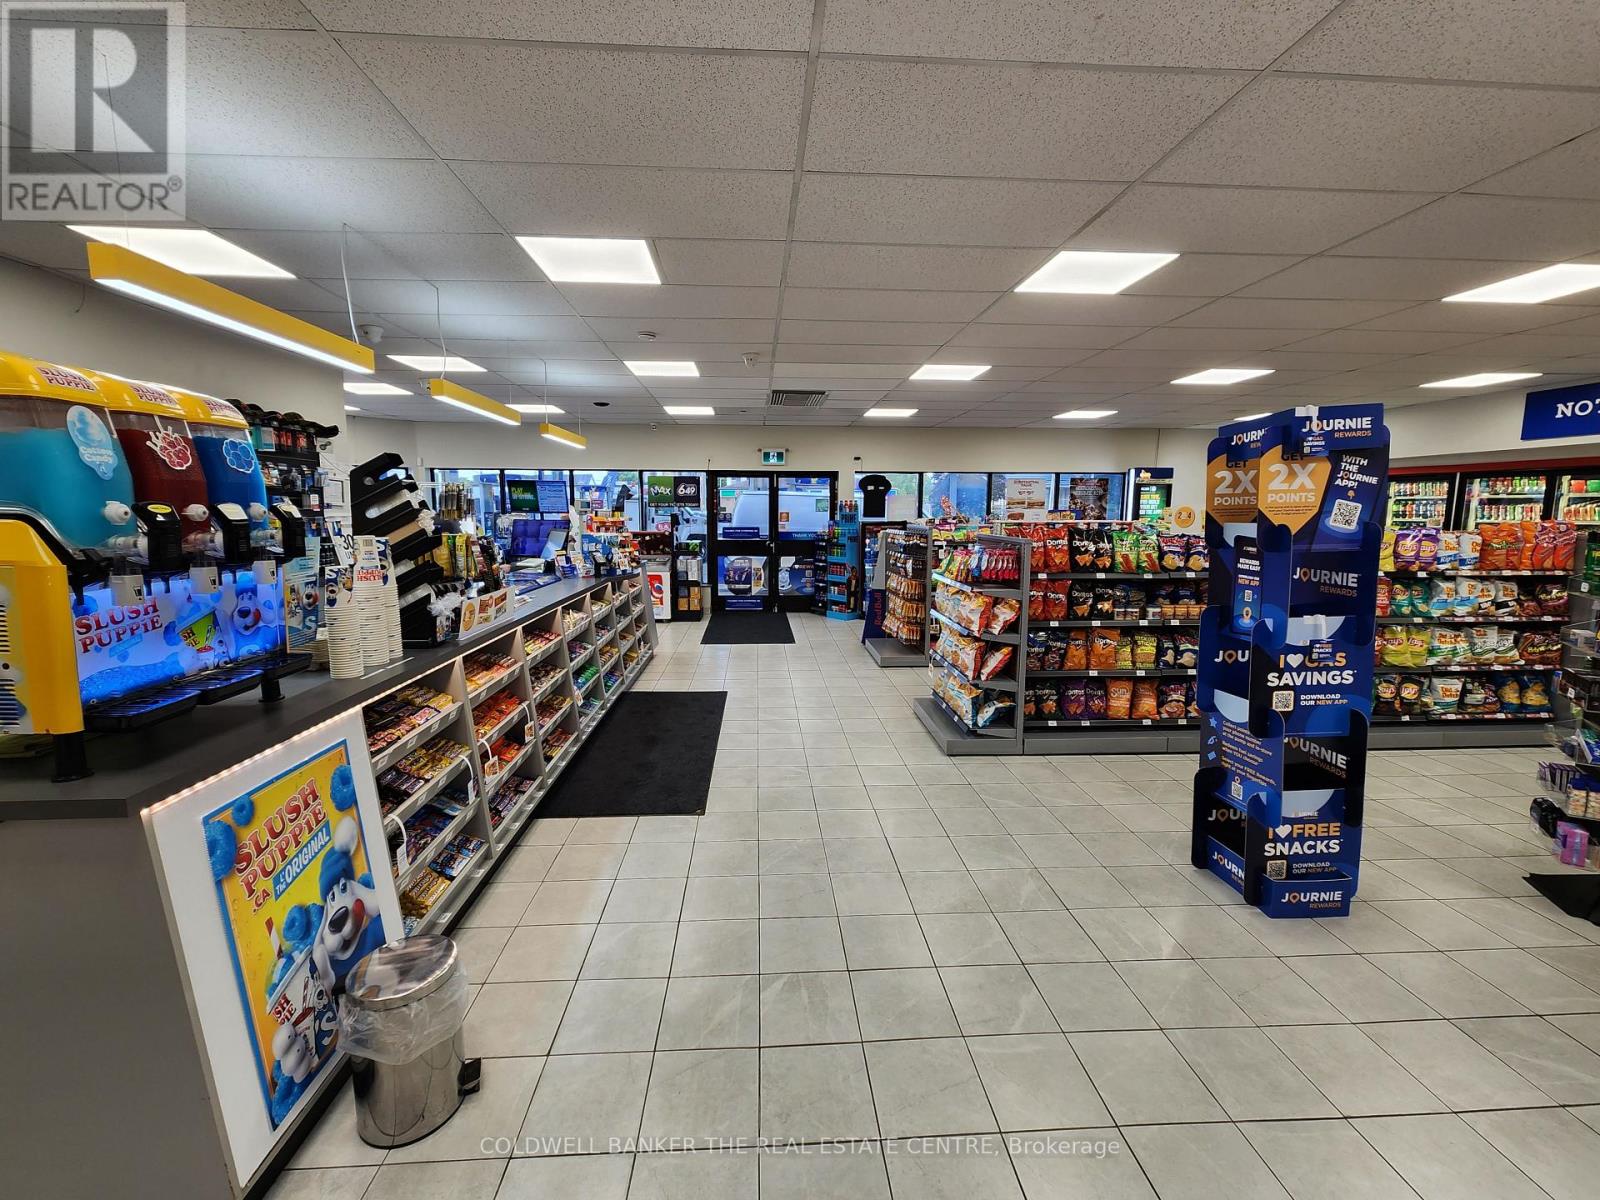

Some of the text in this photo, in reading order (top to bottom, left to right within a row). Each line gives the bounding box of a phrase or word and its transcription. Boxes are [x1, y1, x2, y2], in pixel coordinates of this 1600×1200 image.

[1301, 417, 1373, 432] JOURNIE
[1334, 430, 1372, 439] REWARDS
[1341, 454, 1369, 466] WITH
[1341, 463, 1359, 473] THE
[1214, 469, 1258, 494] 2X
[1268, 463, 1317, 490] 2X
[1334, 479, 1359, 489] APP!
[1337, 472, 1379, 485] JOURNIE
[1214, 496, 1257, 505] POINTS
[1268, 492, 1316, 503] POINTS
[1293, 567, 1359, 588] JOURNIE
[1320, 585, 1358, 598] REWARDS
[75, 598, 160, 636] SLUSH
[79, 614, 163, 654] PUPPIE
[1267, 669, 1355, 687] SAVINGS
[236, 778, 319, 875] SLUSH
[1293, 822, 1341, 838] FREE
[241, 801, 327, 899] PUPPIE
[1264, 838, 1341, 857] SNACKS
[1281, 891, 1343, 904] JOURNIE
[1309, 901, 1341, 909] REWARDS
